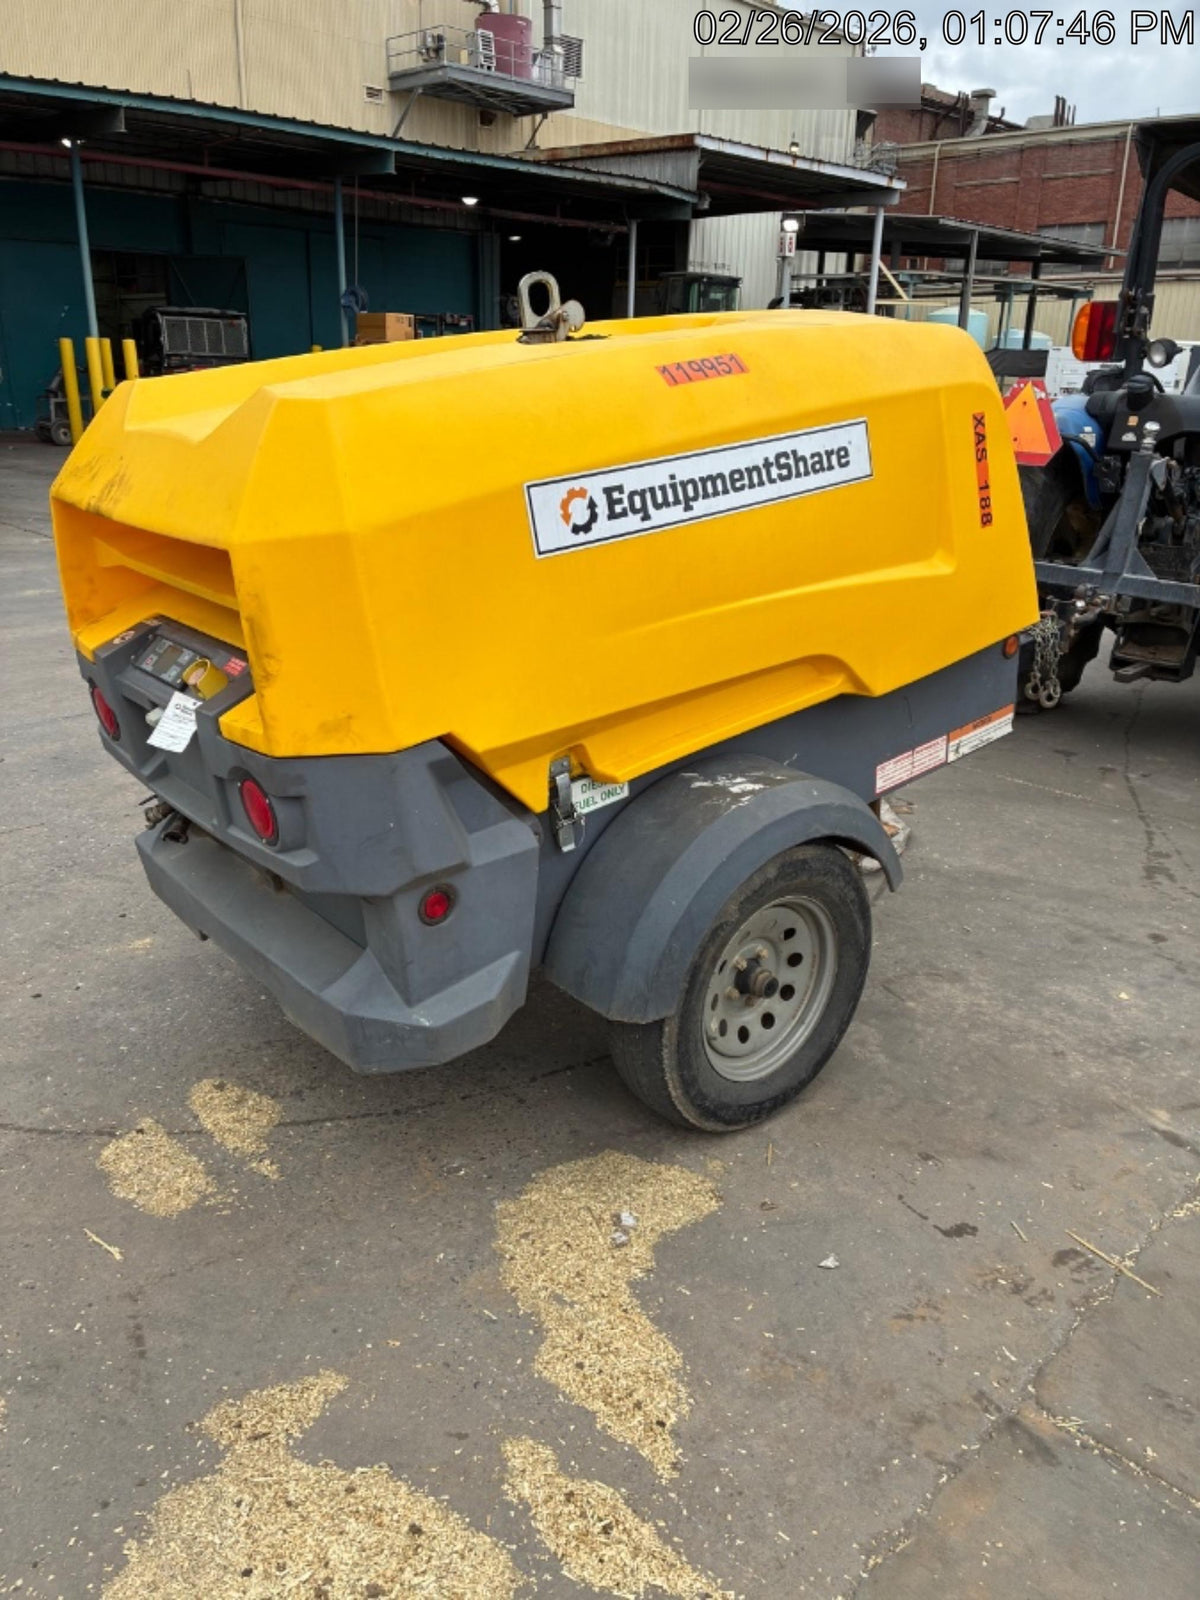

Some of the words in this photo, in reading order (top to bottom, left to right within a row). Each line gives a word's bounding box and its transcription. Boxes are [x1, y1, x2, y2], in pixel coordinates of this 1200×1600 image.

[661, 353, 745, 385] 119951
[972, 412, 987, 462] XAS
[602, 444, 851, 522] EquipmentShare
[979, 480, 992, 526] 188
[601, 784, 625, 801] ONLY
